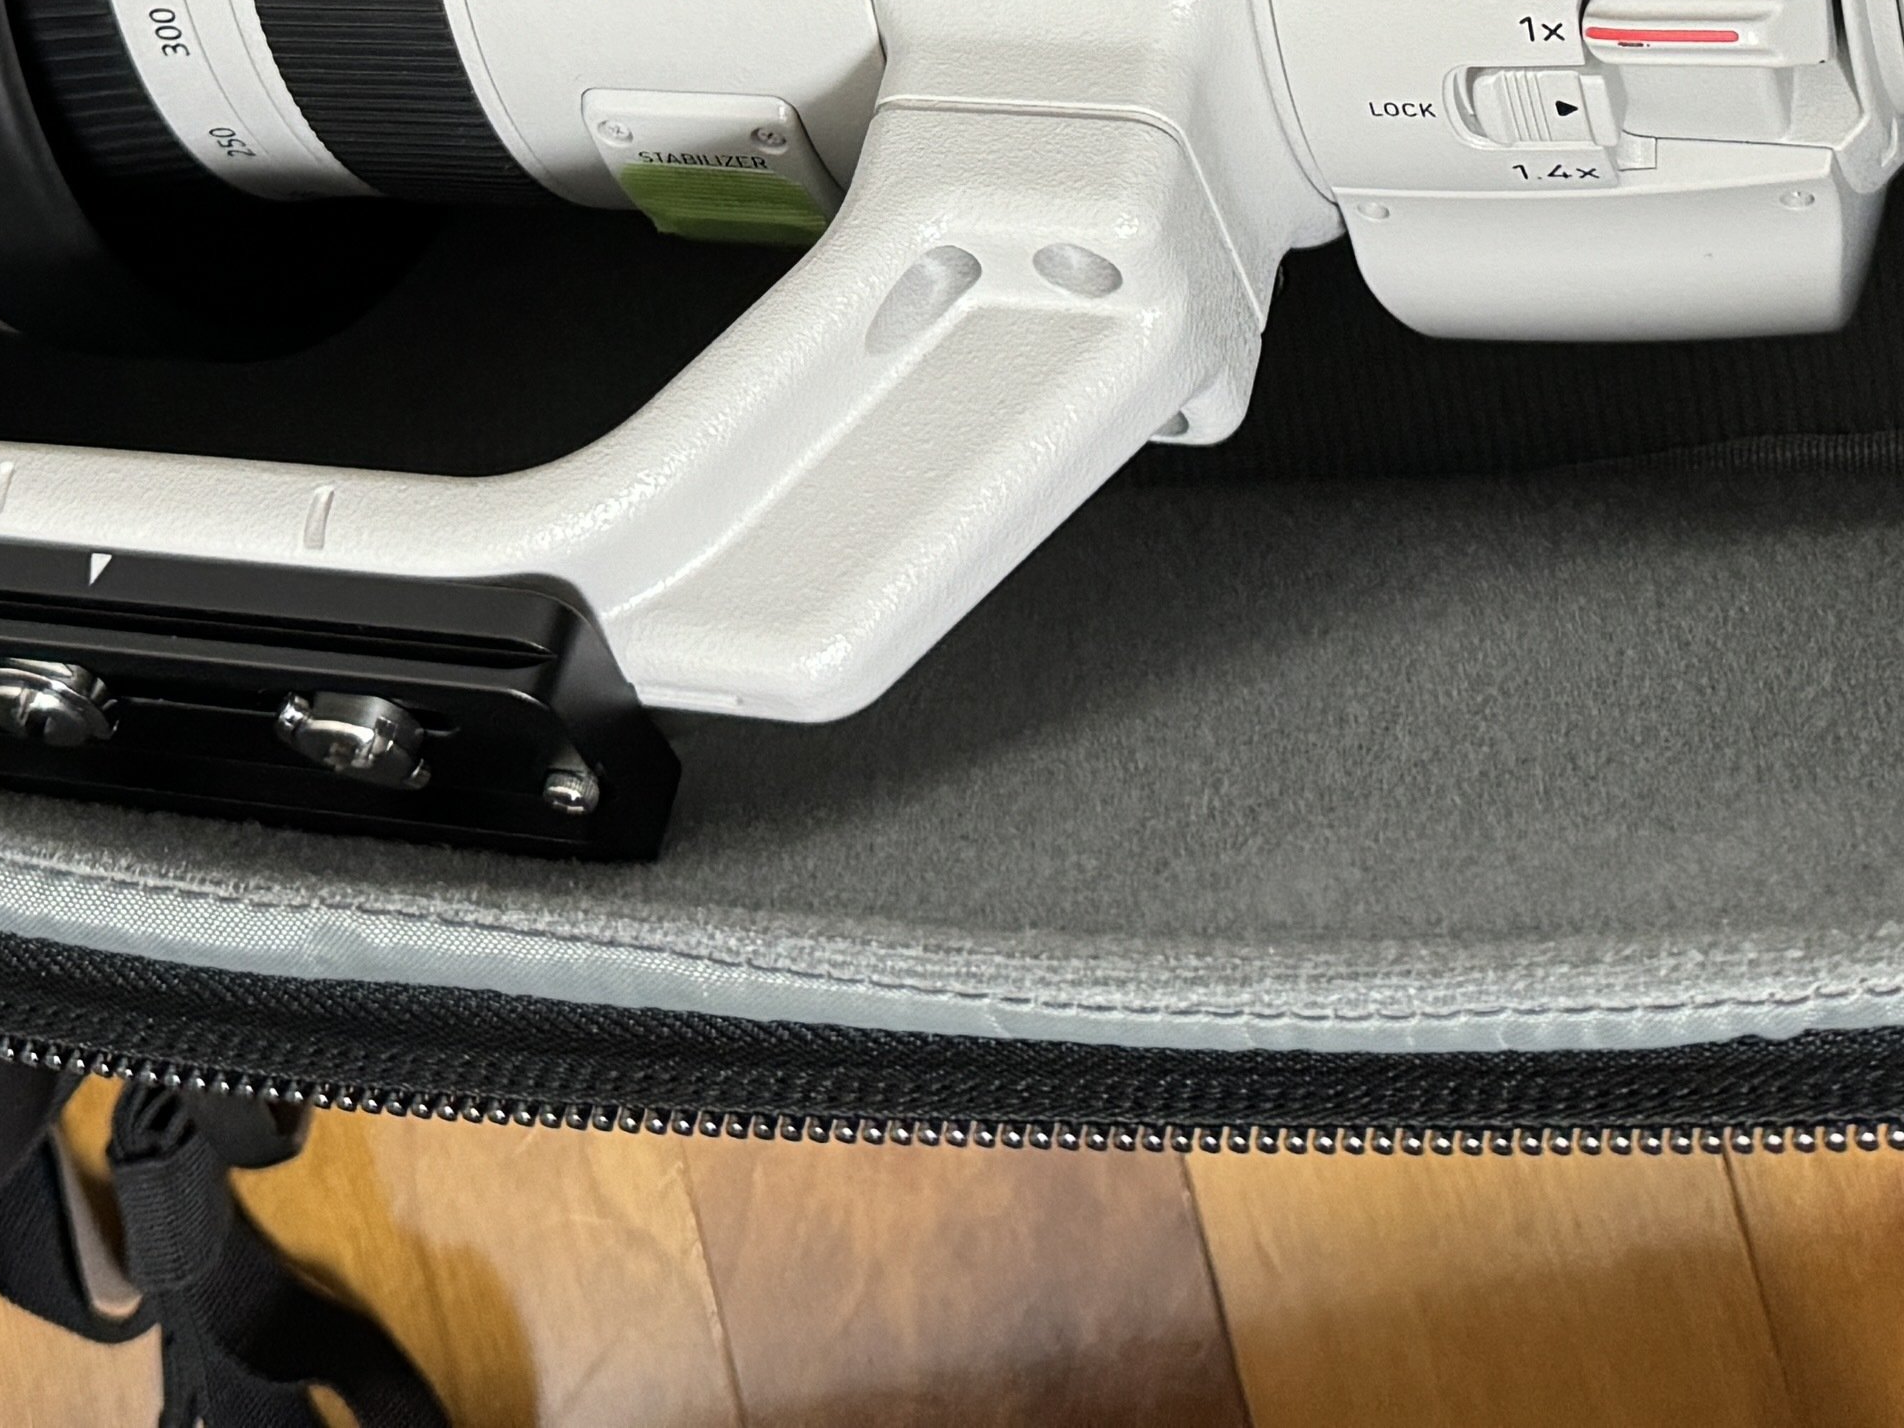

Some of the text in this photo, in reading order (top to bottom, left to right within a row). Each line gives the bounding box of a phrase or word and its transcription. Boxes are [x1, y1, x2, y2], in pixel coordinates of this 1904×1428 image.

[149, 7, 190, 57] 300
[1519, 16, 1566, 43] 1x
[1369, 101, 1437, 119] LOCK
[208, 127, 257, 158] 250
[638, 150, 769, 170] STABILIZER
[1512, 163, 1601, 181] 1.4x
